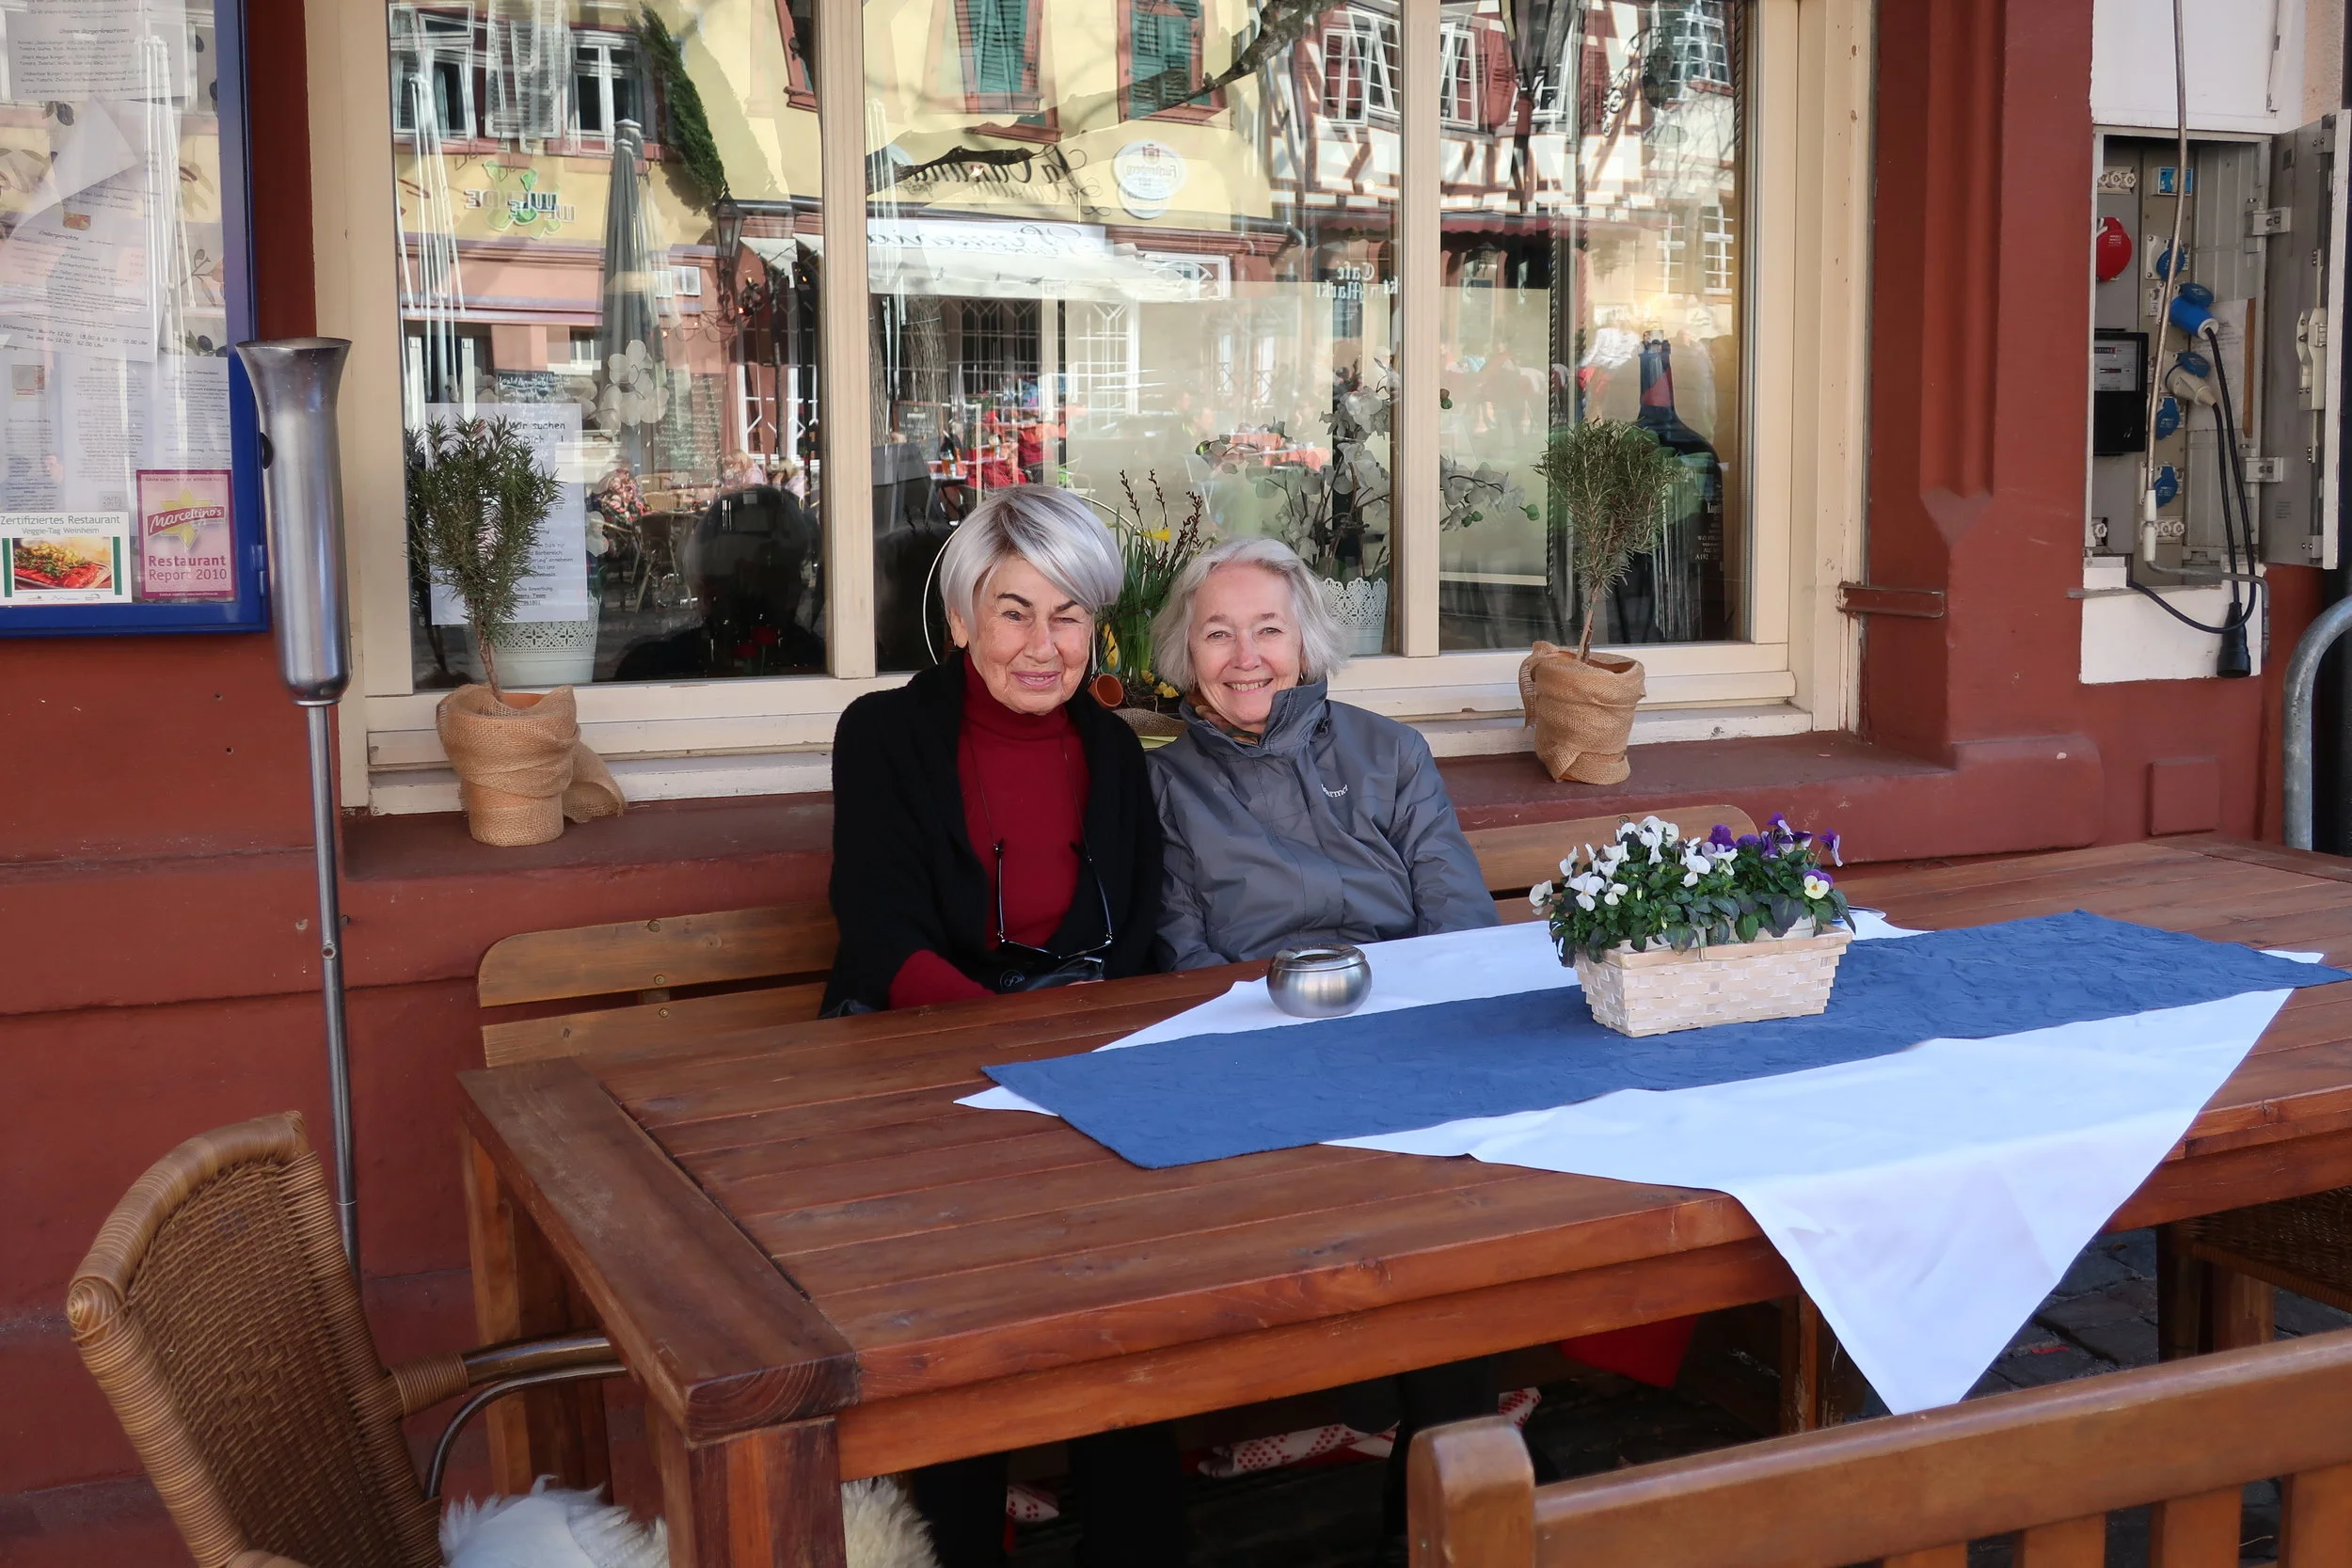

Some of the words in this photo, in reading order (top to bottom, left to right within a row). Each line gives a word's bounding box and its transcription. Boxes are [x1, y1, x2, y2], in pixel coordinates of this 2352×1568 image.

[532, 421, 566, 431] suchen
[524, 435, 545, 444] Dich
[0, 515, 65, 526] Zertifiziertes
[68, 515, 120, 525] Restaurant
[150, 507, 223, 534] Marcellino's
[22, 527, 61, 536] Veggie-Tag
[63, 526, 100, 534] Weinheim
[148, 554, 227, 567] Restaurant
[196, 568, 228, 580] 2010
